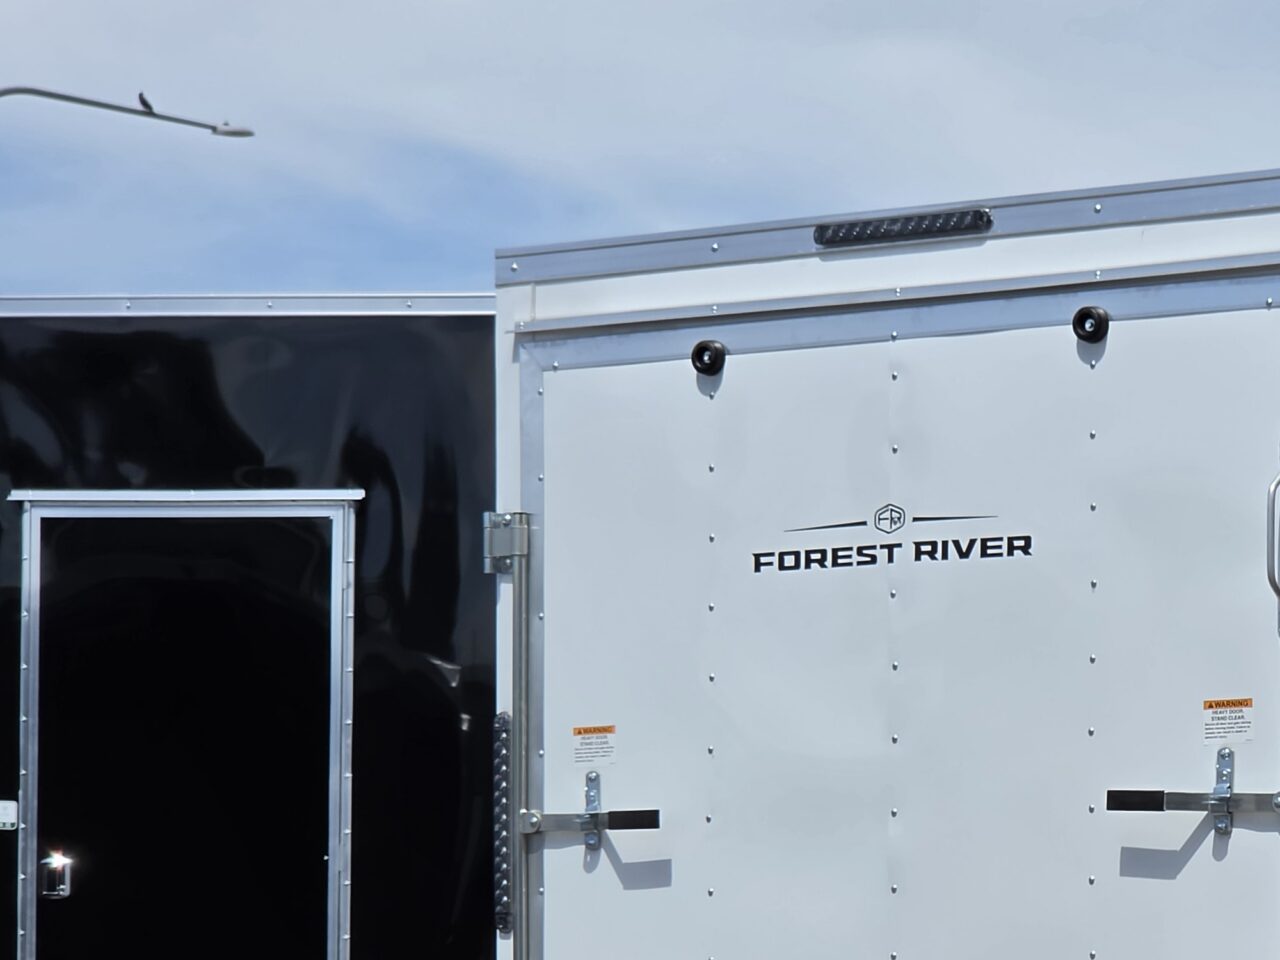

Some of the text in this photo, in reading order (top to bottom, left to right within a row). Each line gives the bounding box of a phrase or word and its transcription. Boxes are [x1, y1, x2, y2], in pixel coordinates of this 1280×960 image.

[752, 535, 1033, 573] FOREST RIVER
[1215, 699, 1249, 709] WARNING
